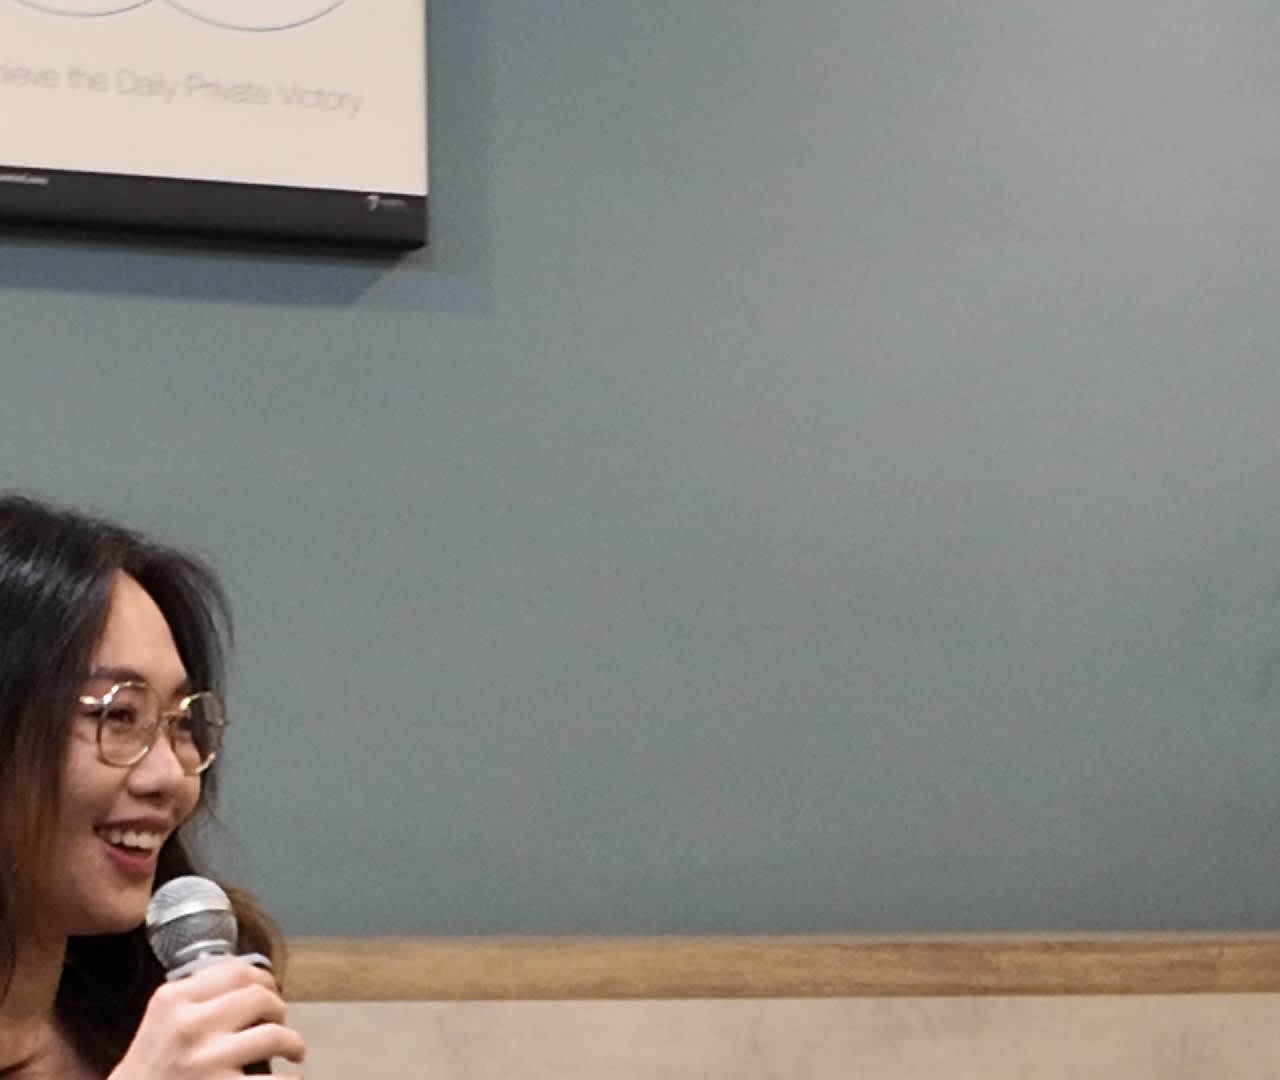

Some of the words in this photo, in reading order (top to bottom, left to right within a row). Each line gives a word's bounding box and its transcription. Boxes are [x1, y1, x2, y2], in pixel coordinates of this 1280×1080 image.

[68, 65, 110, 93] the
[116, 68, 178, 104] Daily
[184, 73, 271, 106] Private
[277, 80, 364, 119] Victory
